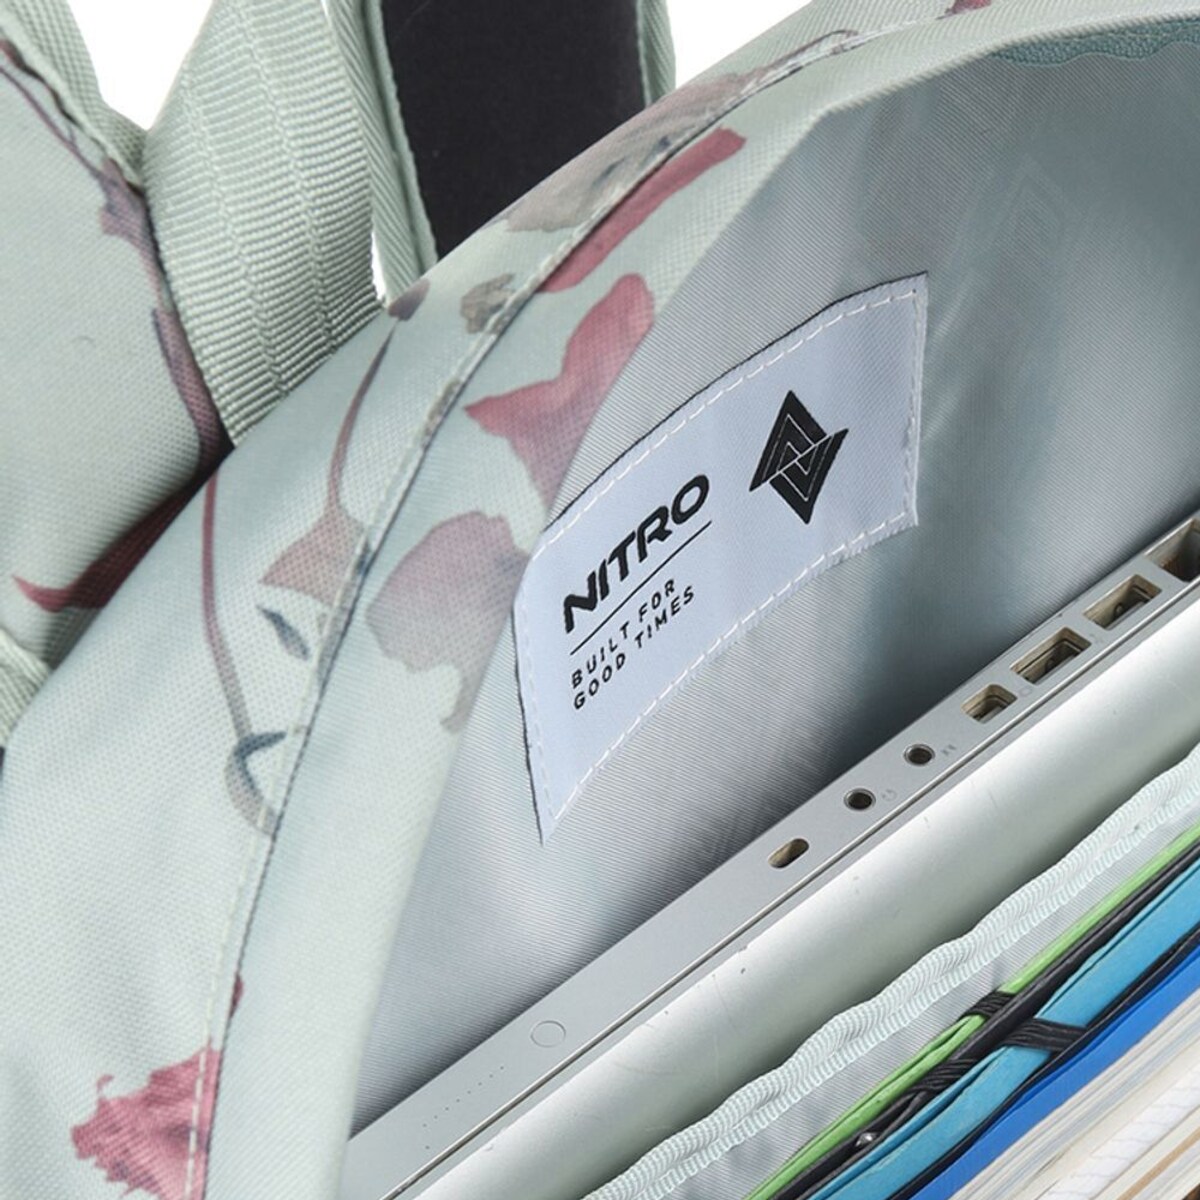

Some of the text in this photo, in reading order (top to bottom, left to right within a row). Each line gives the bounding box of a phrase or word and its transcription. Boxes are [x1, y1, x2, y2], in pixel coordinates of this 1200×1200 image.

[563, 474, 710, 634] NITRO
[571, 579, 675, 689] BUILT FOR
[573, 586, 694, 710] GOOD TIMES
